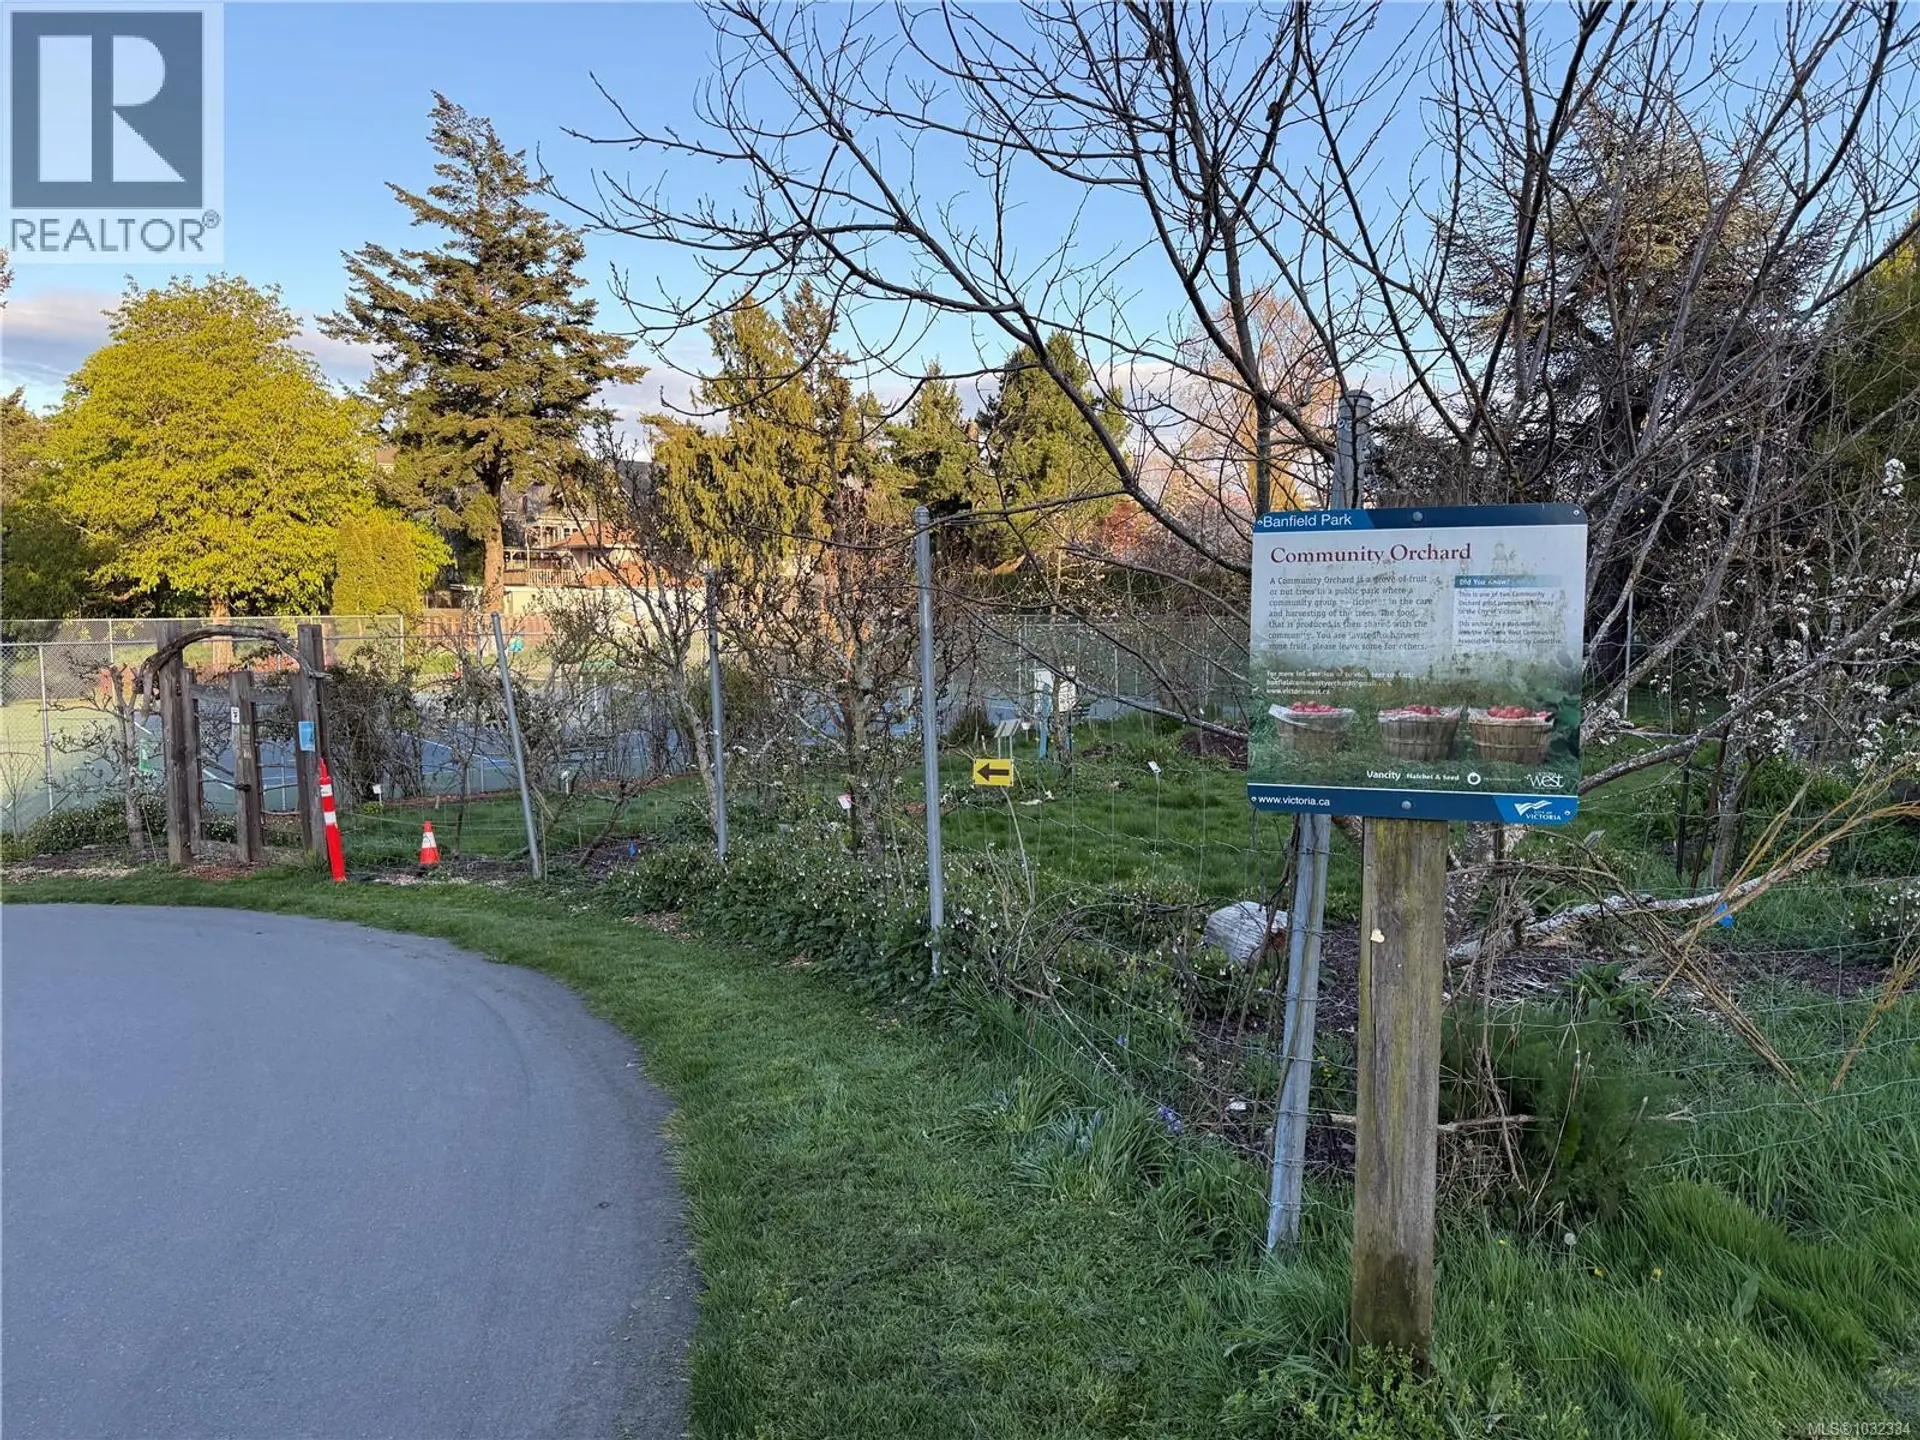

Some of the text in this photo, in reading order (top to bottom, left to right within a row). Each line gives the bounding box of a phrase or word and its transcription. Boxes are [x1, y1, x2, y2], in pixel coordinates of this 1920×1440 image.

[1263, 514, 1352, 528] Banfield Park
[1271, 543, 1471, 565] Community Orchard
[1269, 577, 1276, 585] A
[1278, 577, 1321, 586] Community
[1323, 576, 1354, 584] Orchard
[1356, 575, 1364, 583] is
[1398, 575, 1407, 583] of
[1409, 574, 1427, 583] fruit
[1269, 588, 1278, 596] or
[1280, 588, 1293, 596] nut
[1296, 587, 1315, 596] trees
[1335, 586, 1359, 596] public
[1360, 586, 1380, 596] park
[1382, 586, 1406, 595] where
[1269, 599, 1312, 608] community
[1314, 599, 1337, 608] group
[1400, 598, 1413, 606] the
[1269, 609, 1282, 617] and
[1285, 609, 1326, 618] harvesting
[1328, 608, 1337, 617] of
[1381, 608, 1395, 617] The
[1397, 608, 1415, 617] food
[1269, 620, 1284, 628] that
[1414, 620, 1428, 628] the
[1316, 631, 1331, 639] You
[1313, 642, 1337, 651] please
[1384, 642, 1396, 651] for
[1367, 770, 1401, 781] Vancity
[1258, 796, 1330, 807] www.victoria.ca
